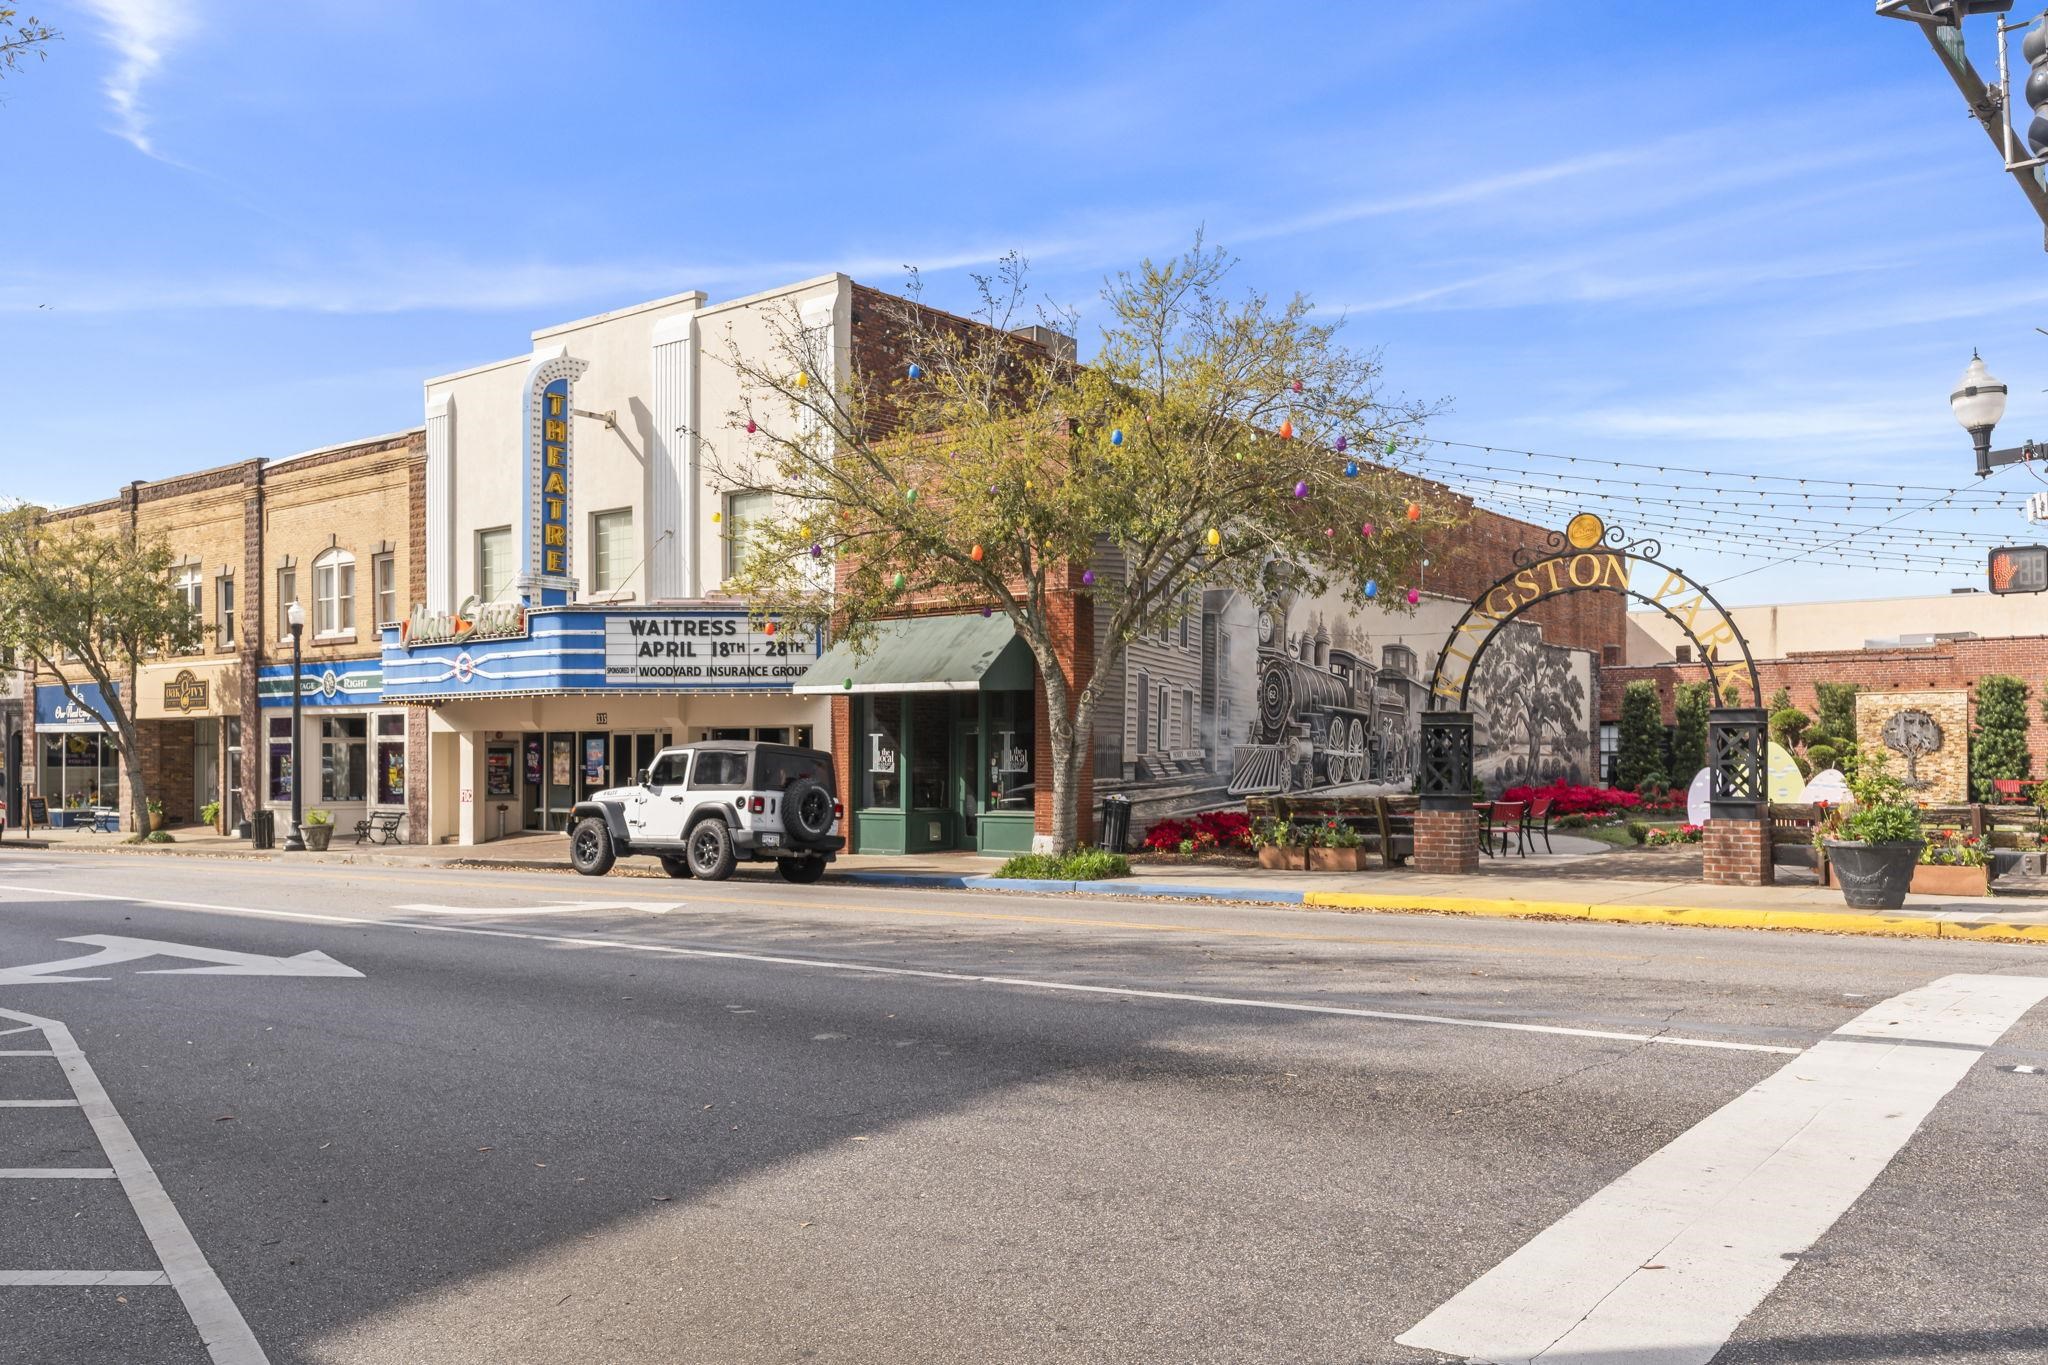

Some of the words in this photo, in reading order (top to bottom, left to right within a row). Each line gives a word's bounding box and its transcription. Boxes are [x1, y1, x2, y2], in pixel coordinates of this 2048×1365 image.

[545, 392, 566, 572] THEATRE
[629, 620, 737, 636] WAITRESS
[1435, 553, 1636, 699] KINGSTON
[1655, 571, 1754, 696] PARK
[638, 641, 697, 657] APRIL
[711, 641, 745, 657] 18TH
[639, 666, 702, 677] WOODYARD
[706, 666, 769, 677] INSURANCE
[772, 666, 808, 677] GROUP
[344, 678, 368, 688] RIGHT
